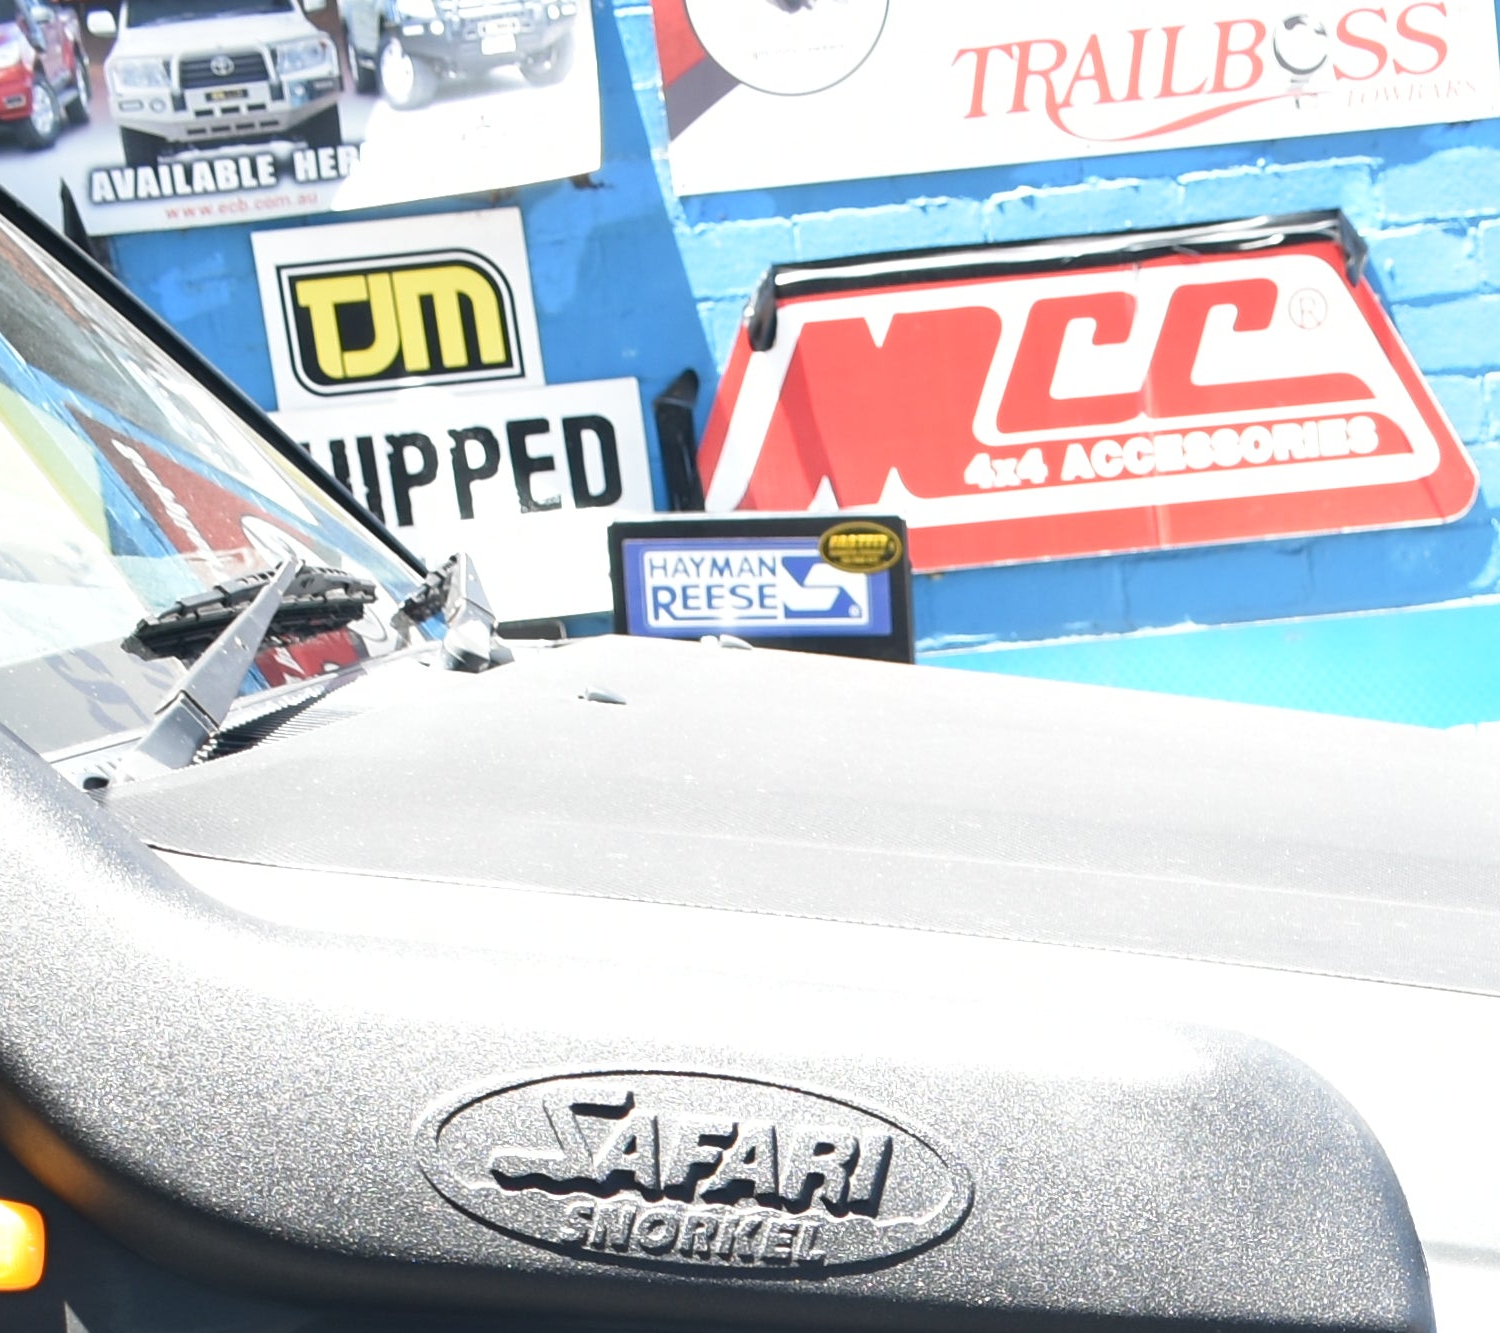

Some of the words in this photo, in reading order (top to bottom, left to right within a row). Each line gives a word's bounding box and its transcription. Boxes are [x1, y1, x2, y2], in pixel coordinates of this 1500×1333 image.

[950, 1, 1450, 126] TRAILBOSS
[91, 153, 278, 203] AVAILABLE
[293, 145, 362, 181] HER
[164, 192, 319, 220] www.ecb.com.au
[295, 265, 506, 381] TJM
[743, 277, 1377, 515] MCC
[963, 447, 1050, 490] 4x4
[1061, 415, 1381, 481] ACCESSORIES
[647, 554, 779, 581] HAYMAN
[652, 583, 780, 622] REESE
[488, 1090, 894, 1218] SAFARI
[559, 1203, 826, 1268] SNORKEL
